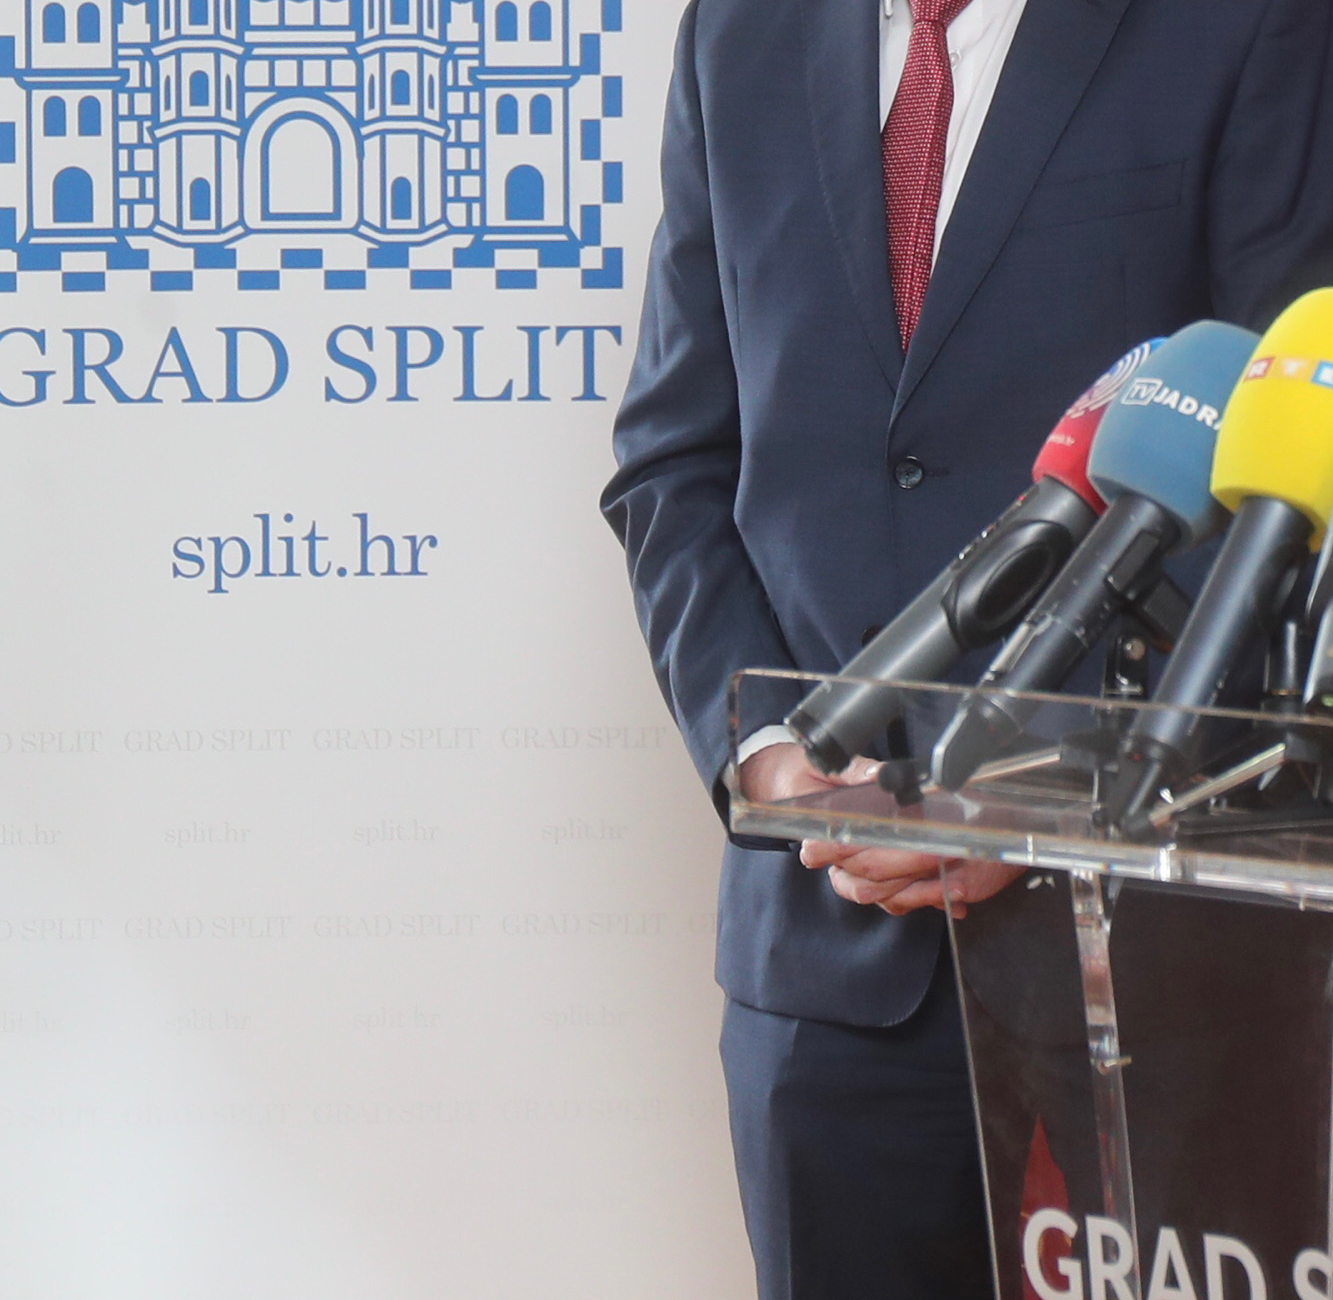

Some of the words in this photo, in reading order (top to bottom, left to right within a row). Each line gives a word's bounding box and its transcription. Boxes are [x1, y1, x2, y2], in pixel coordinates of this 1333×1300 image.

[0, 325, 290, 407] GRAD
[324, 324, 622, 404] SPLIT
[172, 512, 438, 594] split.hr
[123, 729, 204, 752] GRAD
[211, 729, 292, 751] SPLIT
[313, 728, 393, 751] GRAD
[400, 727, 480, 750] SPLIT
[1021, 1207, 1267, 1300] GRAD
